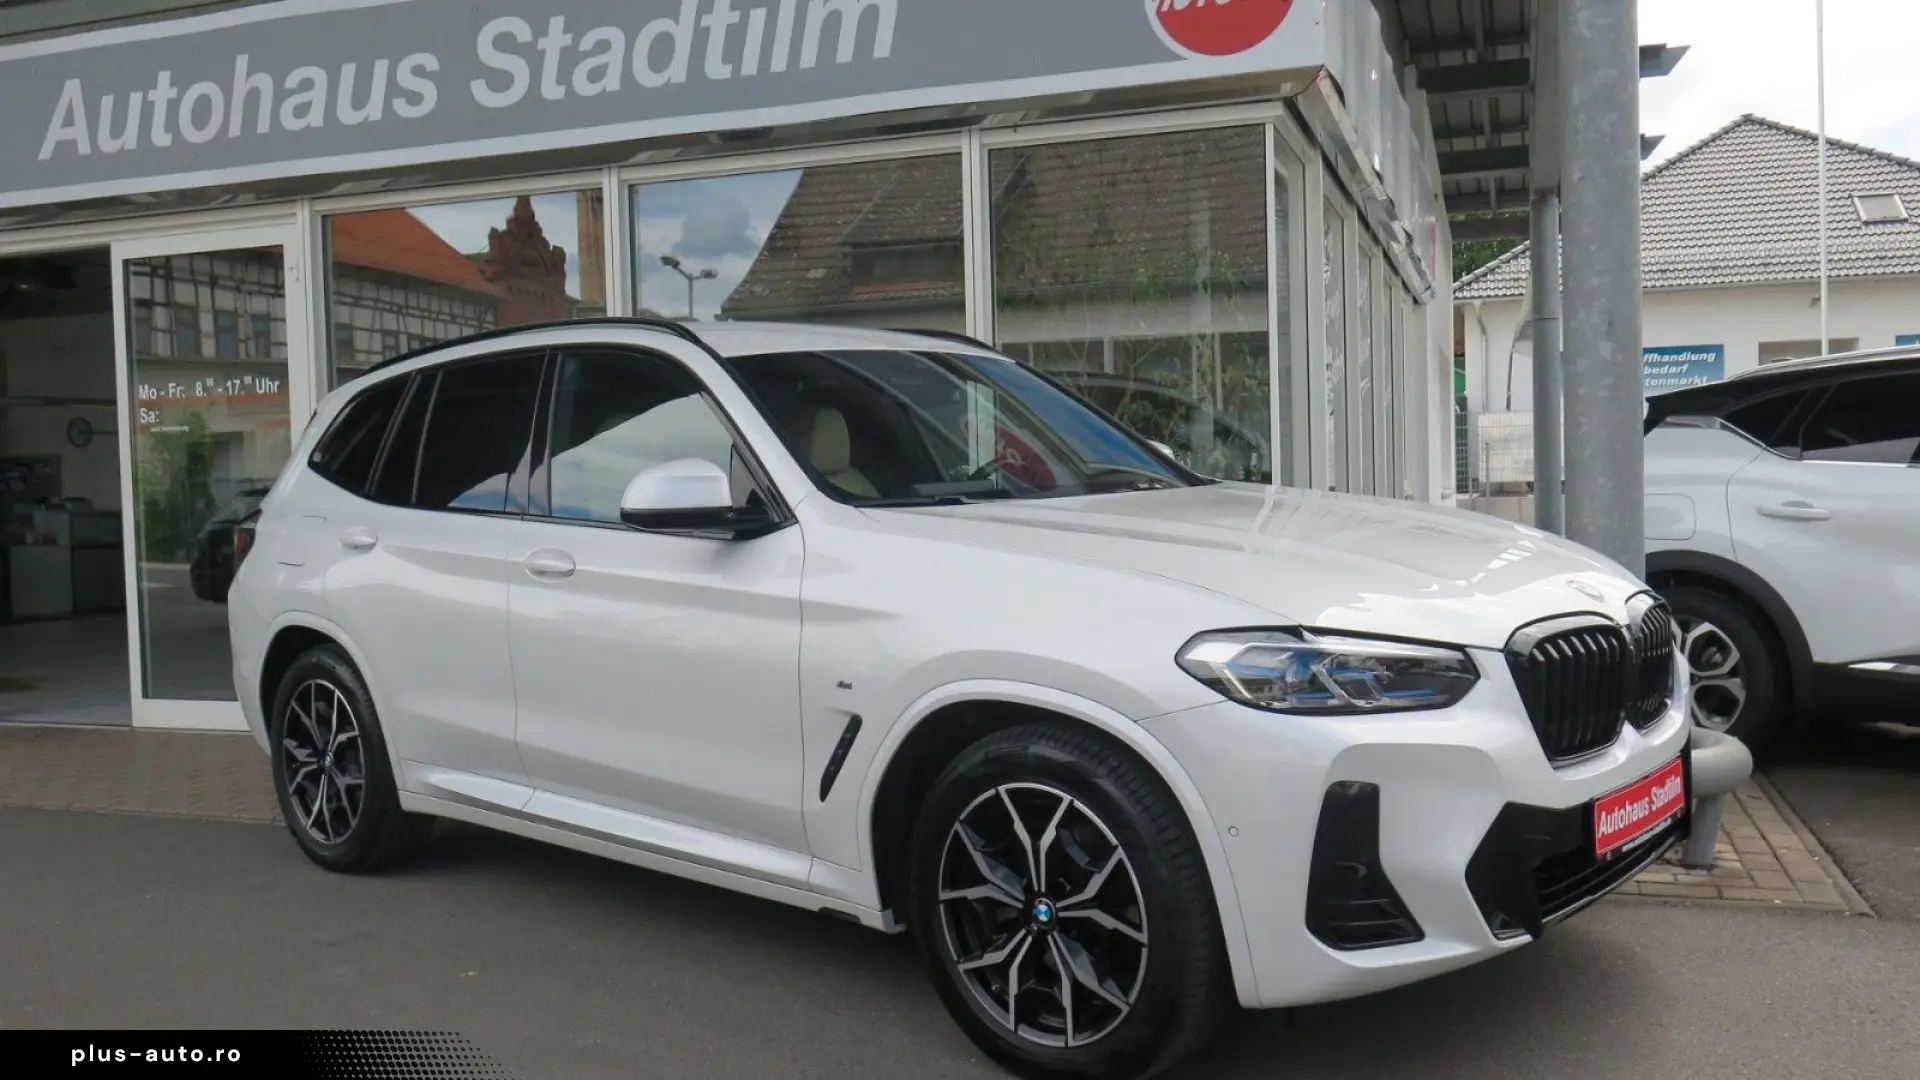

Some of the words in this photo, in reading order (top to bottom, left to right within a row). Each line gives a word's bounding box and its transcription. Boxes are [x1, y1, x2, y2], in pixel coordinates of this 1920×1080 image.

[37, 53, 440, 161] Autohaus
[470, 0, 898, 107] Stadtilm
[138, 385, 157, 400] Mo
[255, 377, 280, 394] Uhr
[139, 407, 160, 424] Sa:
[1599, 797, 1650, 837] Autohaus
